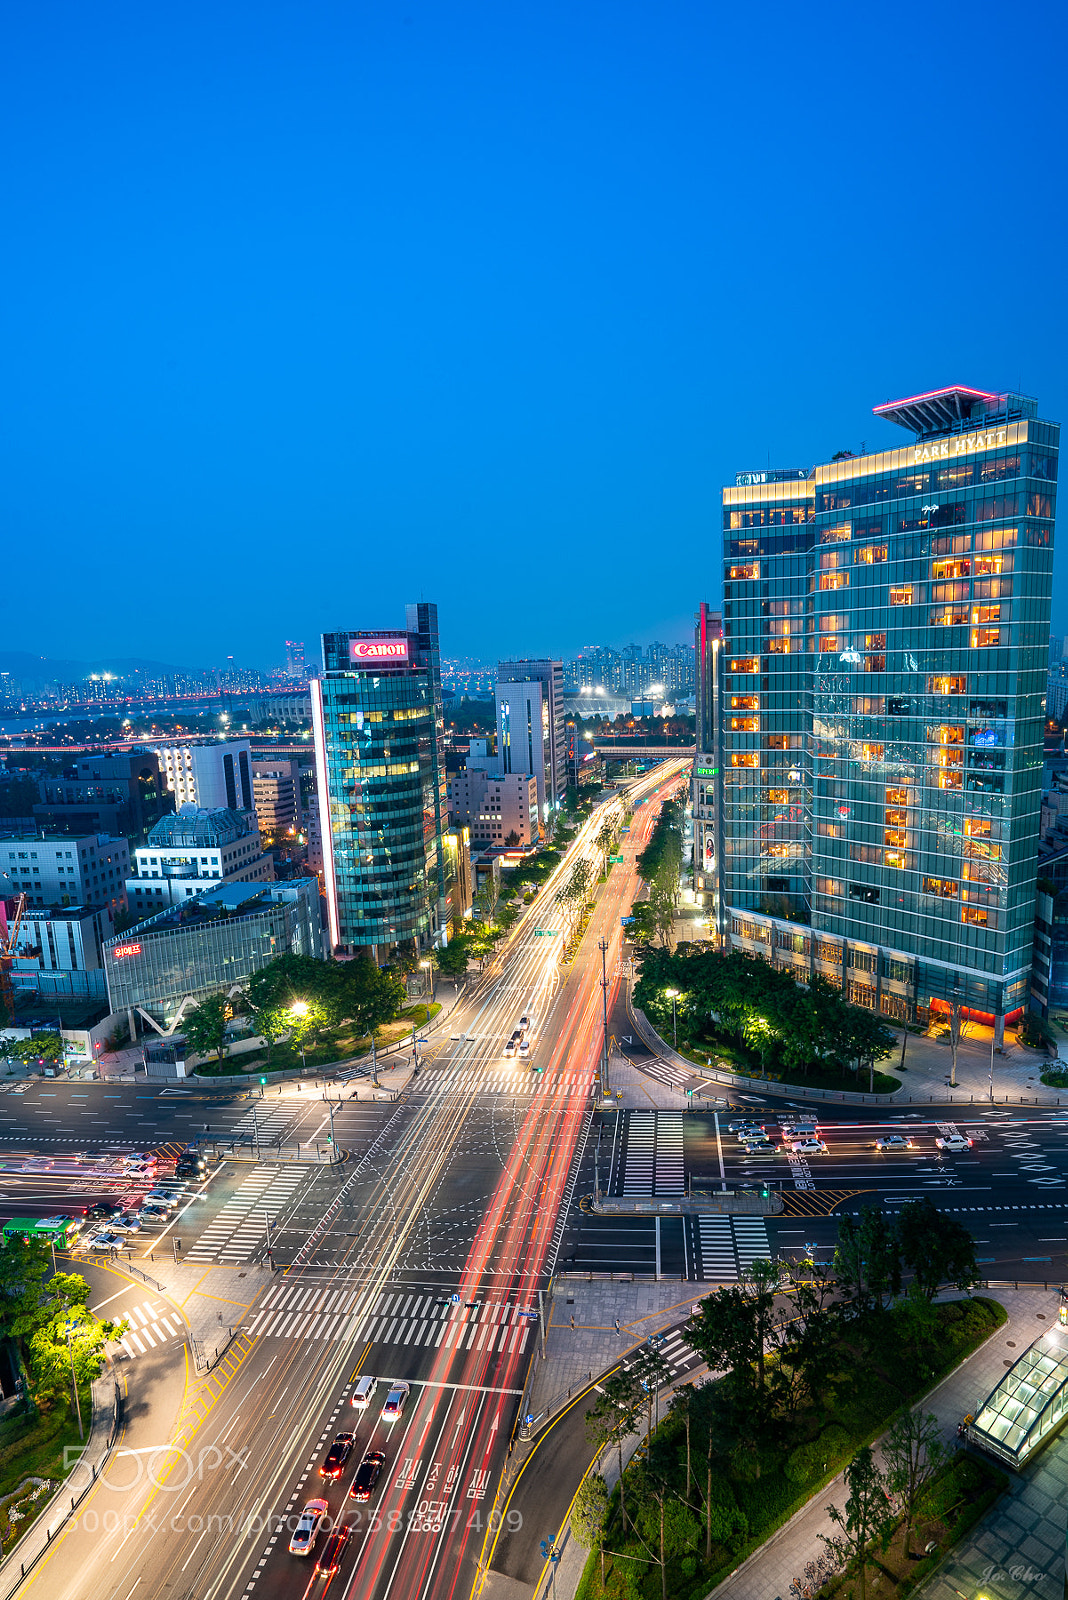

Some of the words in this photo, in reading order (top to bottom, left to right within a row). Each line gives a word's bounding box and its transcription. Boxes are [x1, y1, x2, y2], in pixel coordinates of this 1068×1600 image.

[914, 443, 949, 461] PARK
[955, 431, 1006, 452] HYATT
[353, 643, 406, 657] Canon
